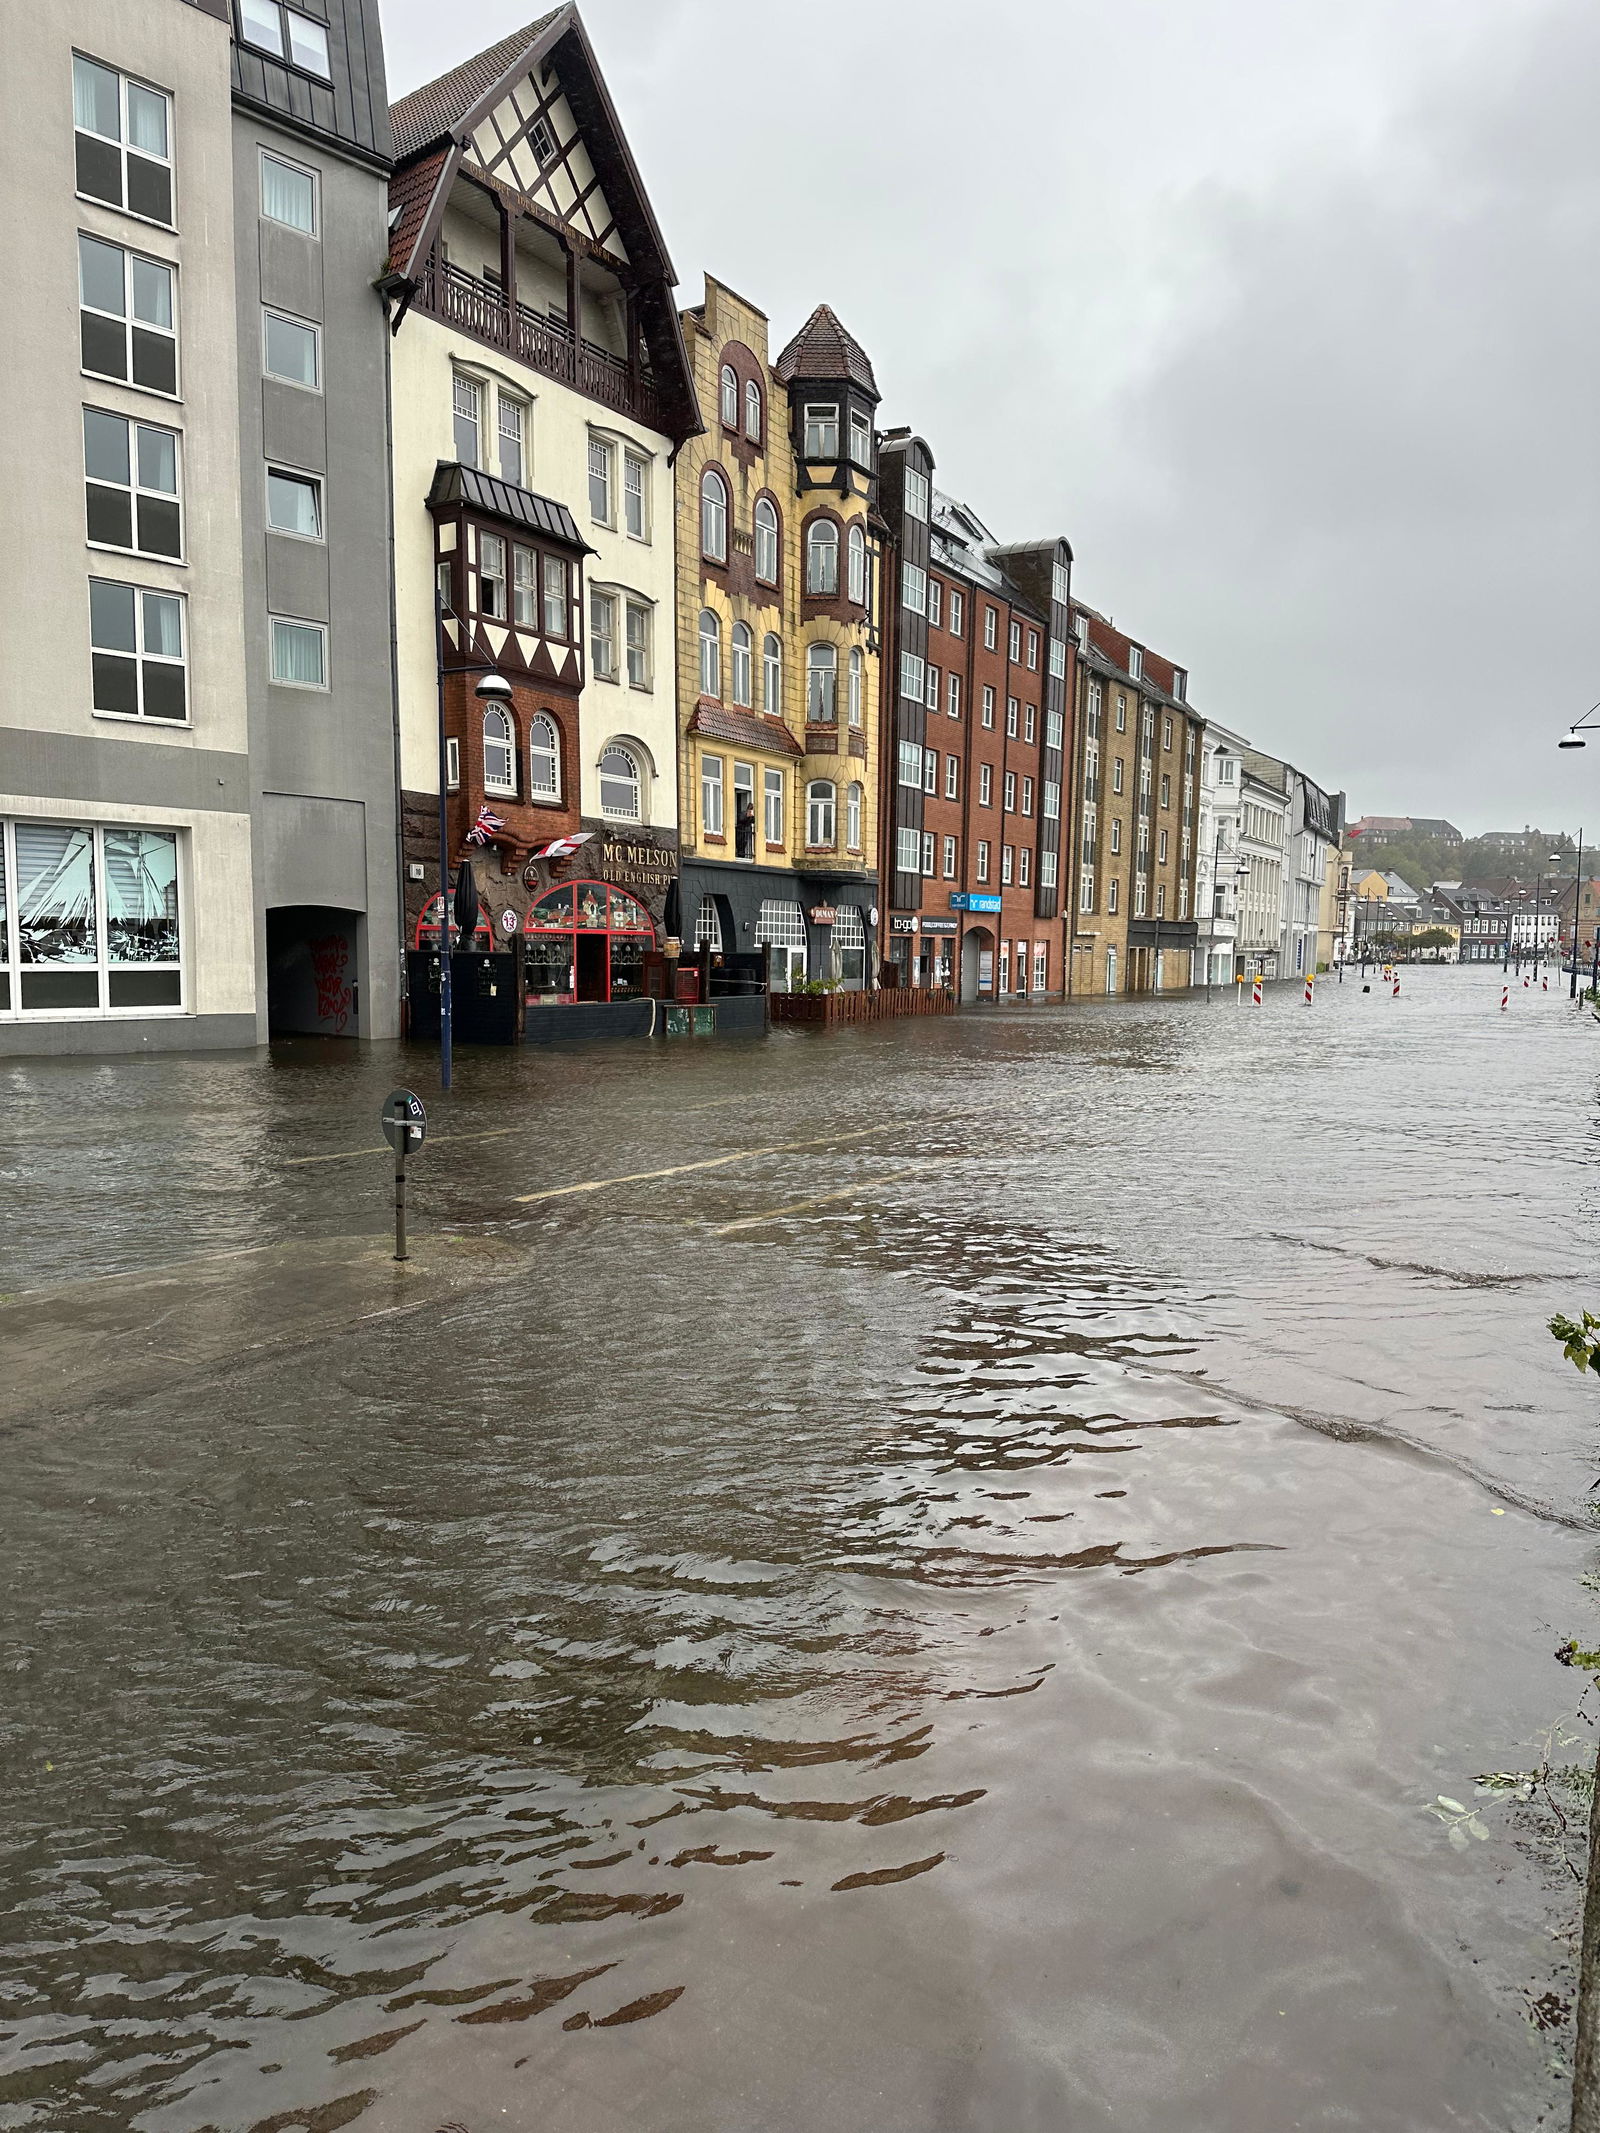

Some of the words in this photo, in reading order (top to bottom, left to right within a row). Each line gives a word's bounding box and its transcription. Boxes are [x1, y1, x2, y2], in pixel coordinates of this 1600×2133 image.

[603, 869, 621, 882] OLD
[624, 871, 660, 885] ENGLISH
[894, 917, 912, 932] to-go
